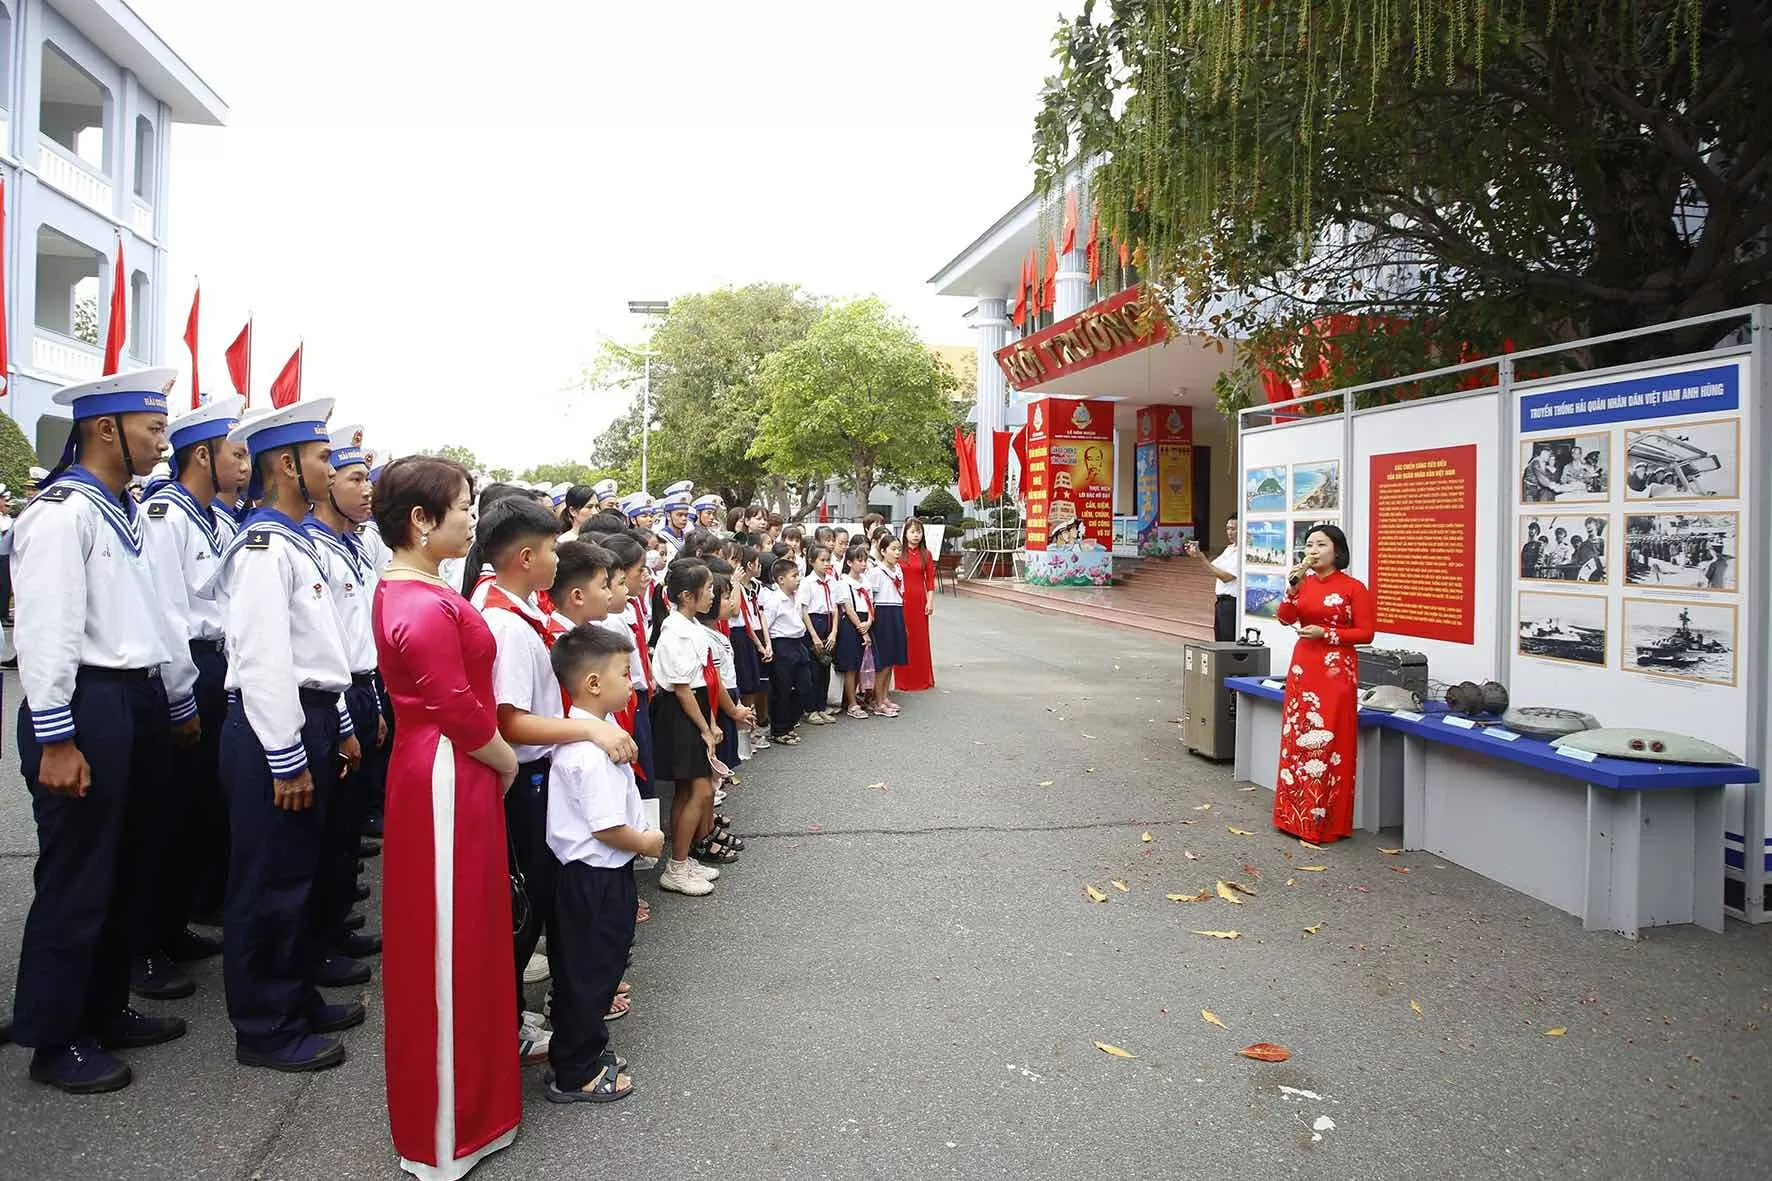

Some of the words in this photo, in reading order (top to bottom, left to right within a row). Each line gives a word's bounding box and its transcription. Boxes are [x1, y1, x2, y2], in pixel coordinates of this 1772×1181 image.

[1530, 404, 1553, 419] TRUYỀN
[1553, 400, 1574, 416] THỐNG
[1588, 397, 1606, 413] QUÂN
[1644, 390, 1661, 407] VIỆT
[1662, 389, 1681, 403] NAM
[1682, 386, 1699, 400] ANH
[1700, 382, 1724, 398] HÙNG
